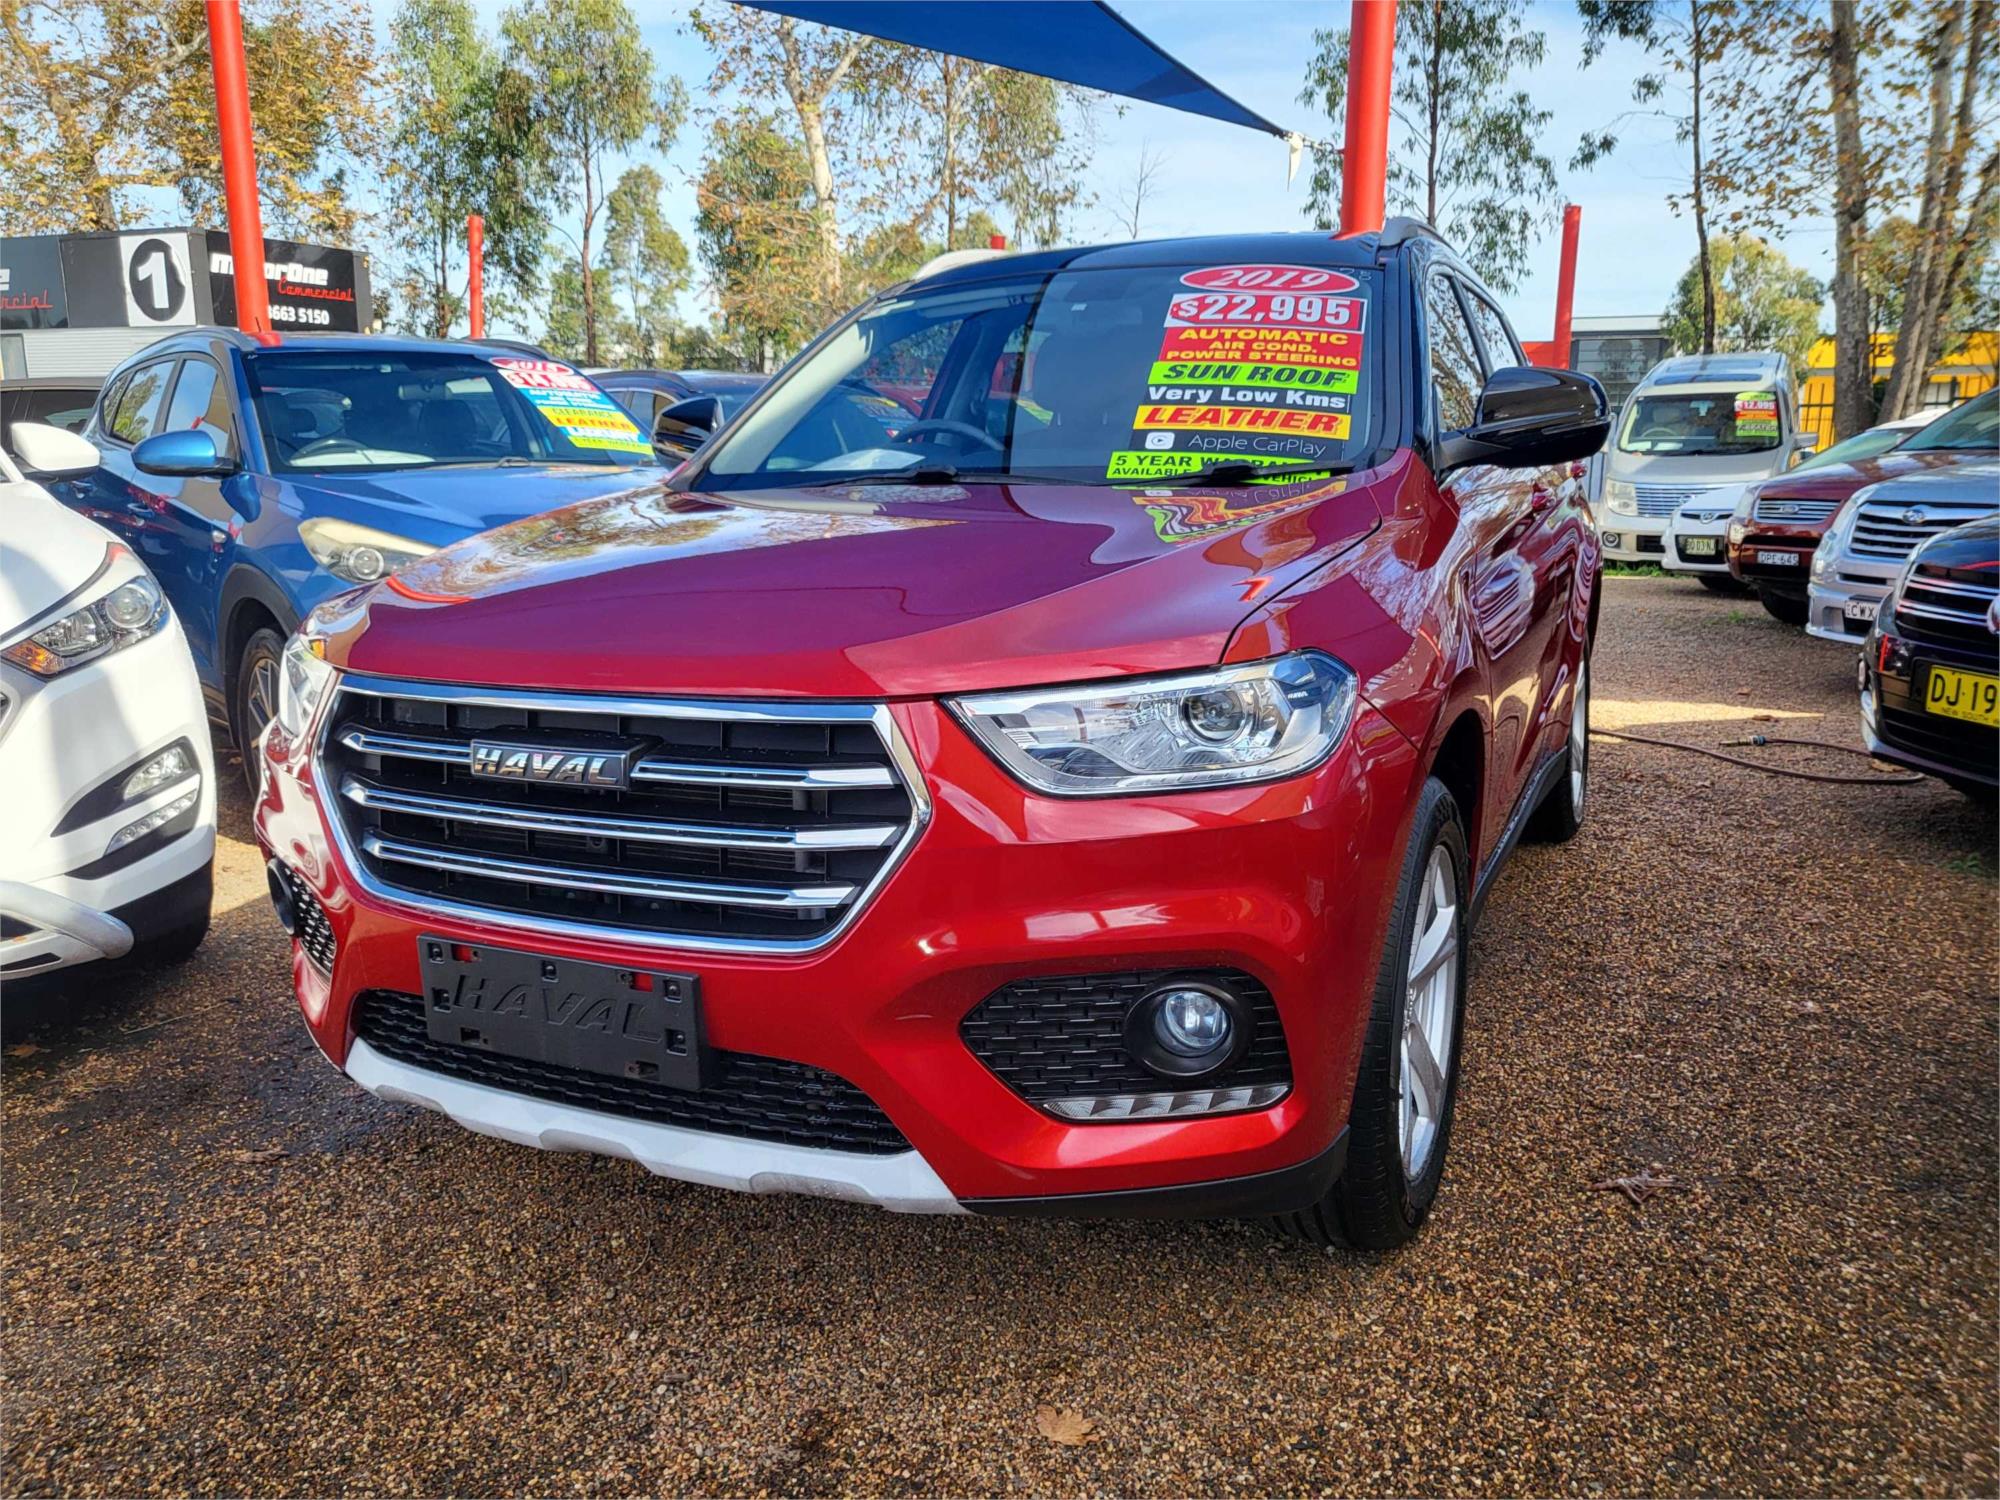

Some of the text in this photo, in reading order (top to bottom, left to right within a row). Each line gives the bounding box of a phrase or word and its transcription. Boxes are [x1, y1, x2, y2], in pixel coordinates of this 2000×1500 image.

[277, 276, 354, 302] Commercial
[1206, 269, 1329, 289] 2019
[297, 307, 330, 325] 5150
[1178, 294, 1351, 325] $22,995
[1179, 328, 1349, 345] AUTOMATIC
[1208, 340, 1317, 353] AIR COND.
[1166, 350, 1358, 366] POWER STEERING
[1163, 364, 1350, 387] SUN ROOF
[1149, 386, 1346, 408] Very Low Kms
[1143, 406, 1342, 433] LEATHER
[1188, 434, 1327, 457] Apple CarPlay
[1115, 455, 1128, 466] 5
[1136, 455, 1192, 466] YEAR
[475, 747, 618, 784] HAVAL
[453, 974, 663, 1043] HAVAL
